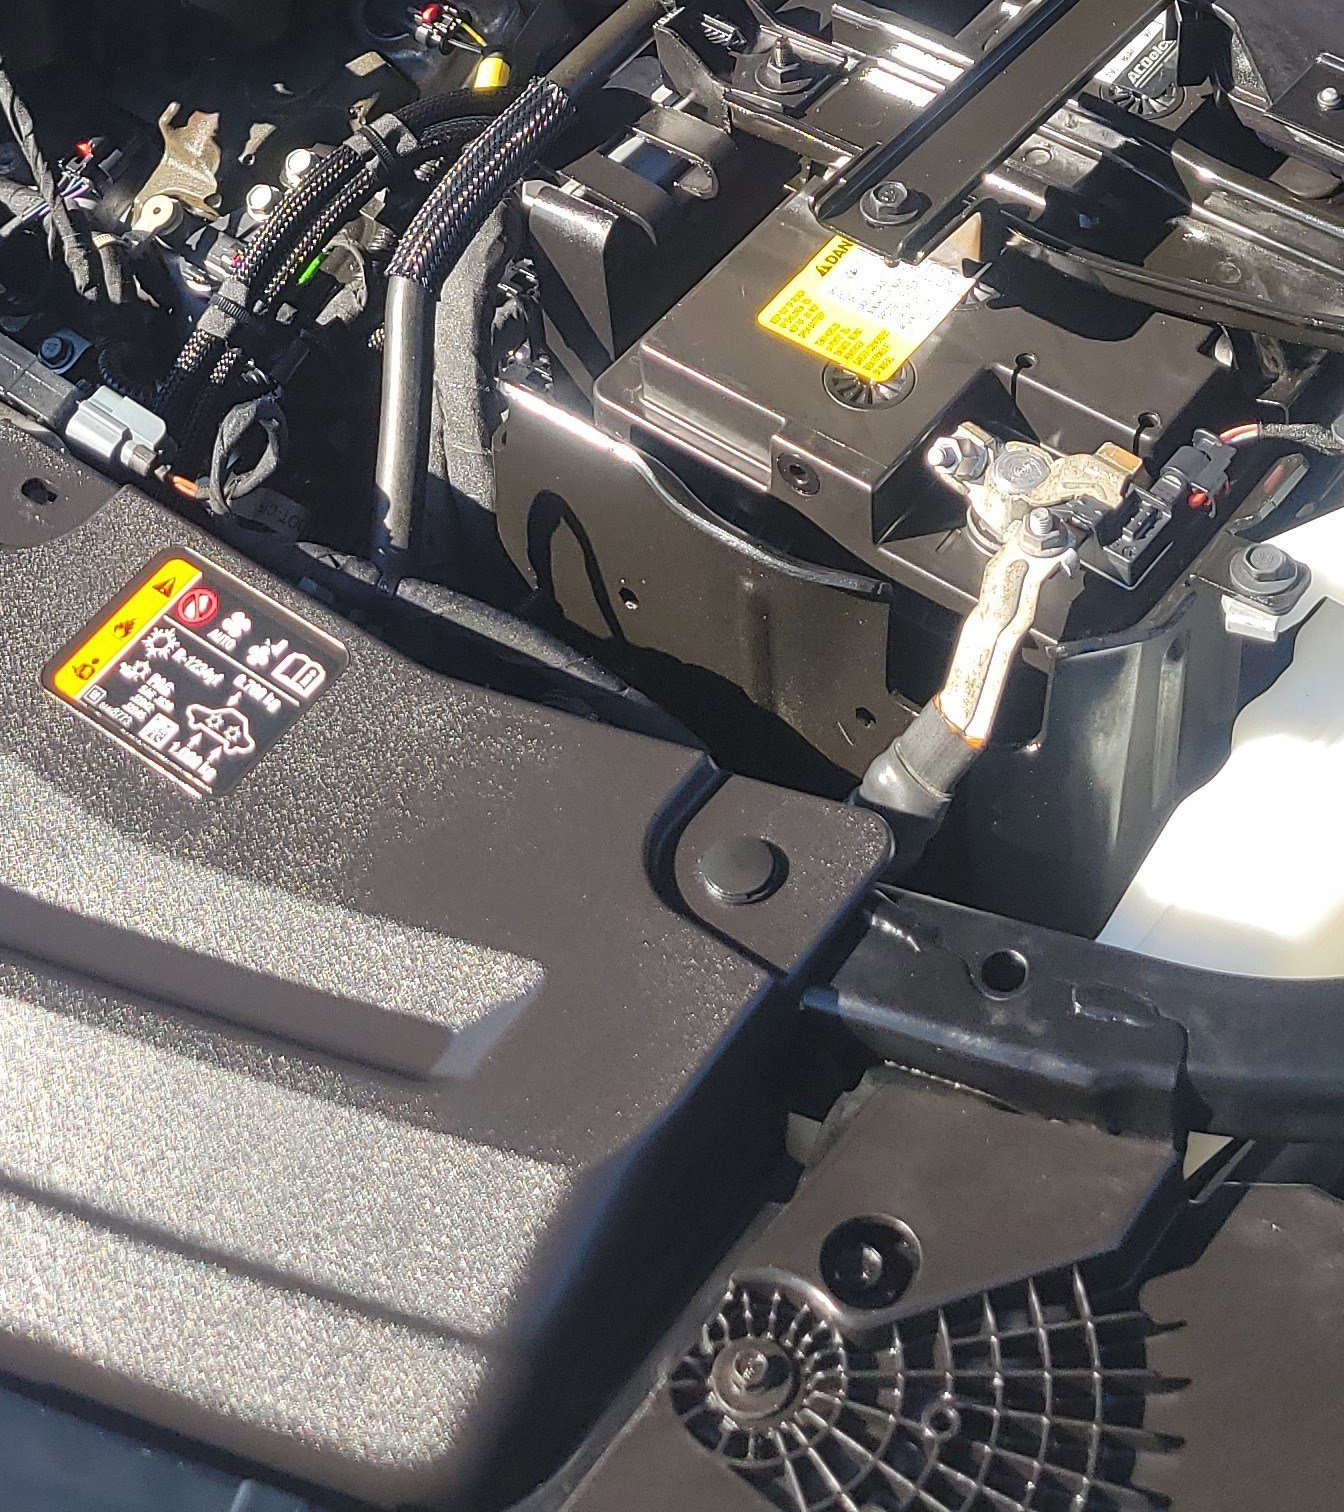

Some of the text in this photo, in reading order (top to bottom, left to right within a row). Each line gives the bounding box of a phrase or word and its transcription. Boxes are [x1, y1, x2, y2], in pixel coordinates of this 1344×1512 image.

[1127, 41, 1169, 85] ACDelc
[825, 239, 854, 272] DAN
[207, 627, 237, 652] AUTO
